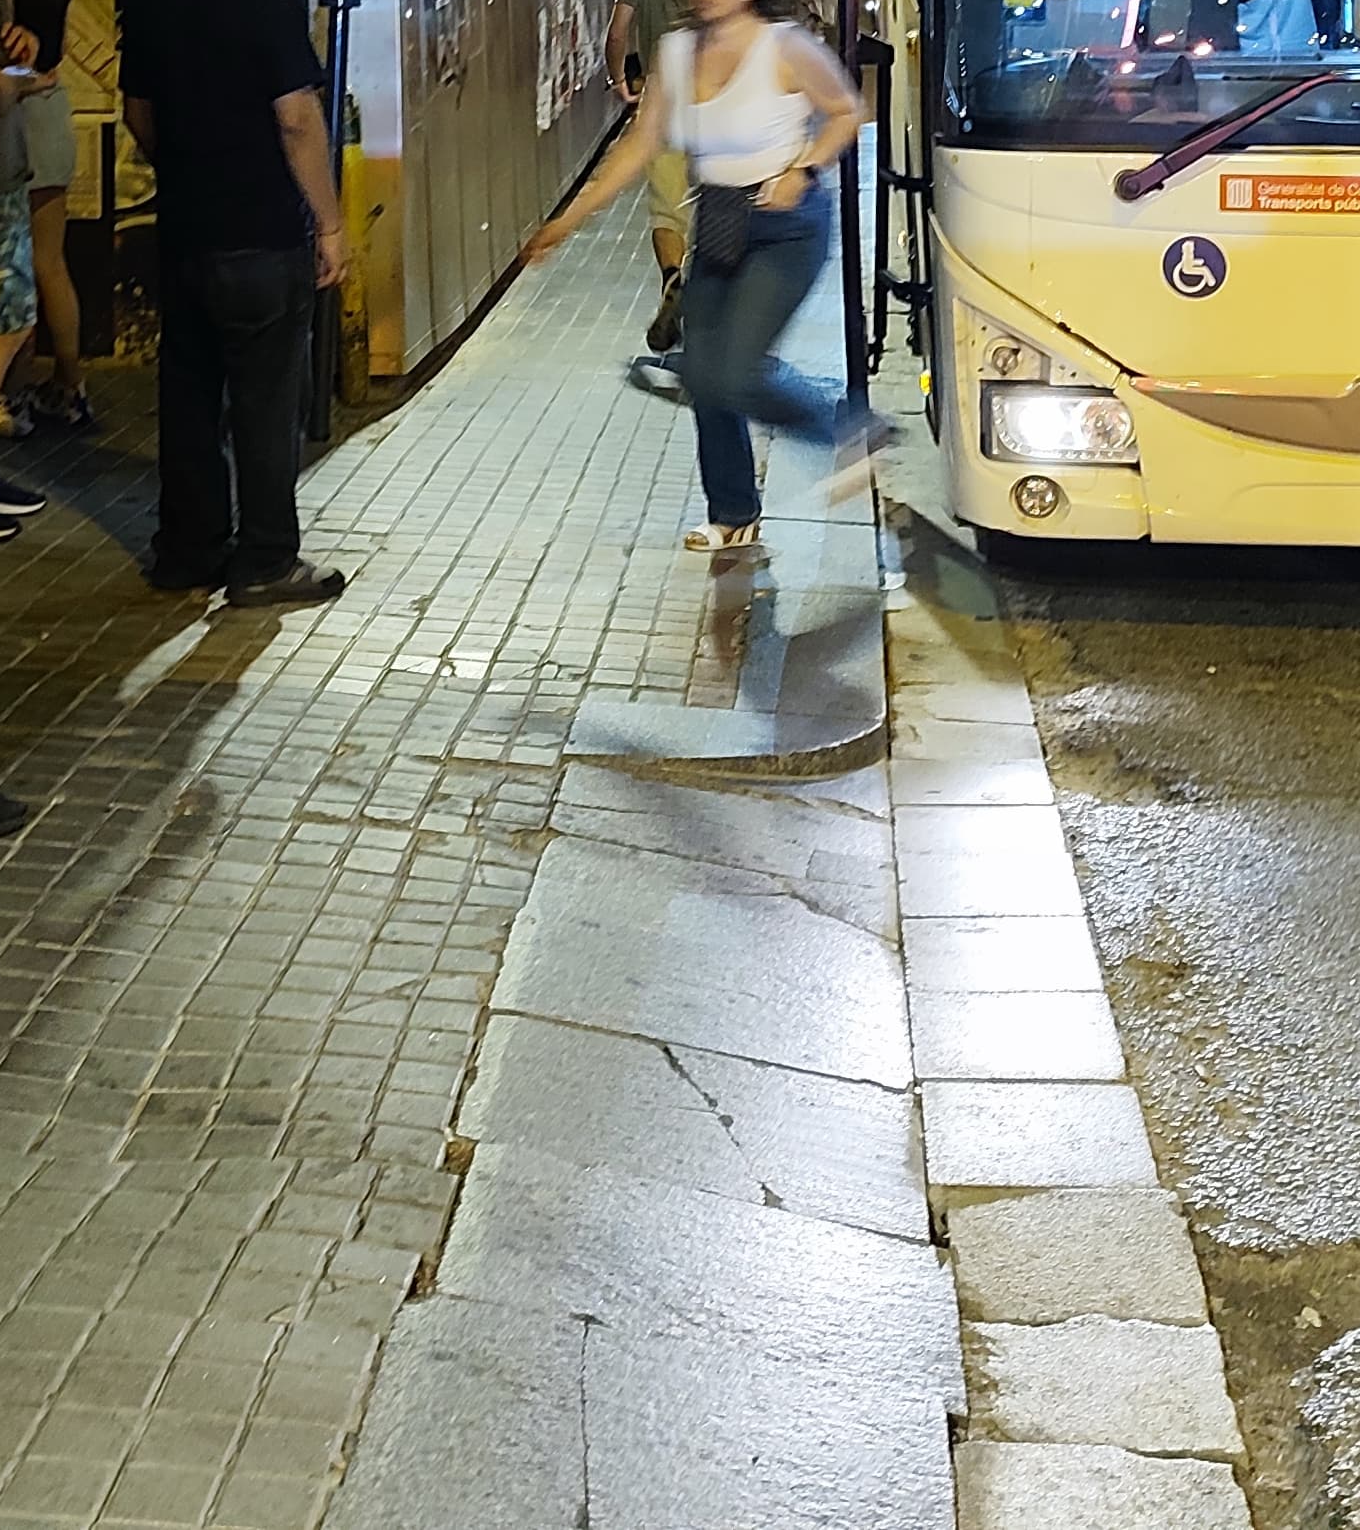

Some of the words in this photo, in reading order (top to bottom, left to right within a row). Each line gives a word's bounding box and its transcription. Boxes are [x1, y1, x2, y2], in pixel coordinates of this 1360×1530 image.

[1257, 181, 1325, 197] Generalitat
[1328, 183, 1345, 197] de
[1257, 196, 1332, 212] Transports
